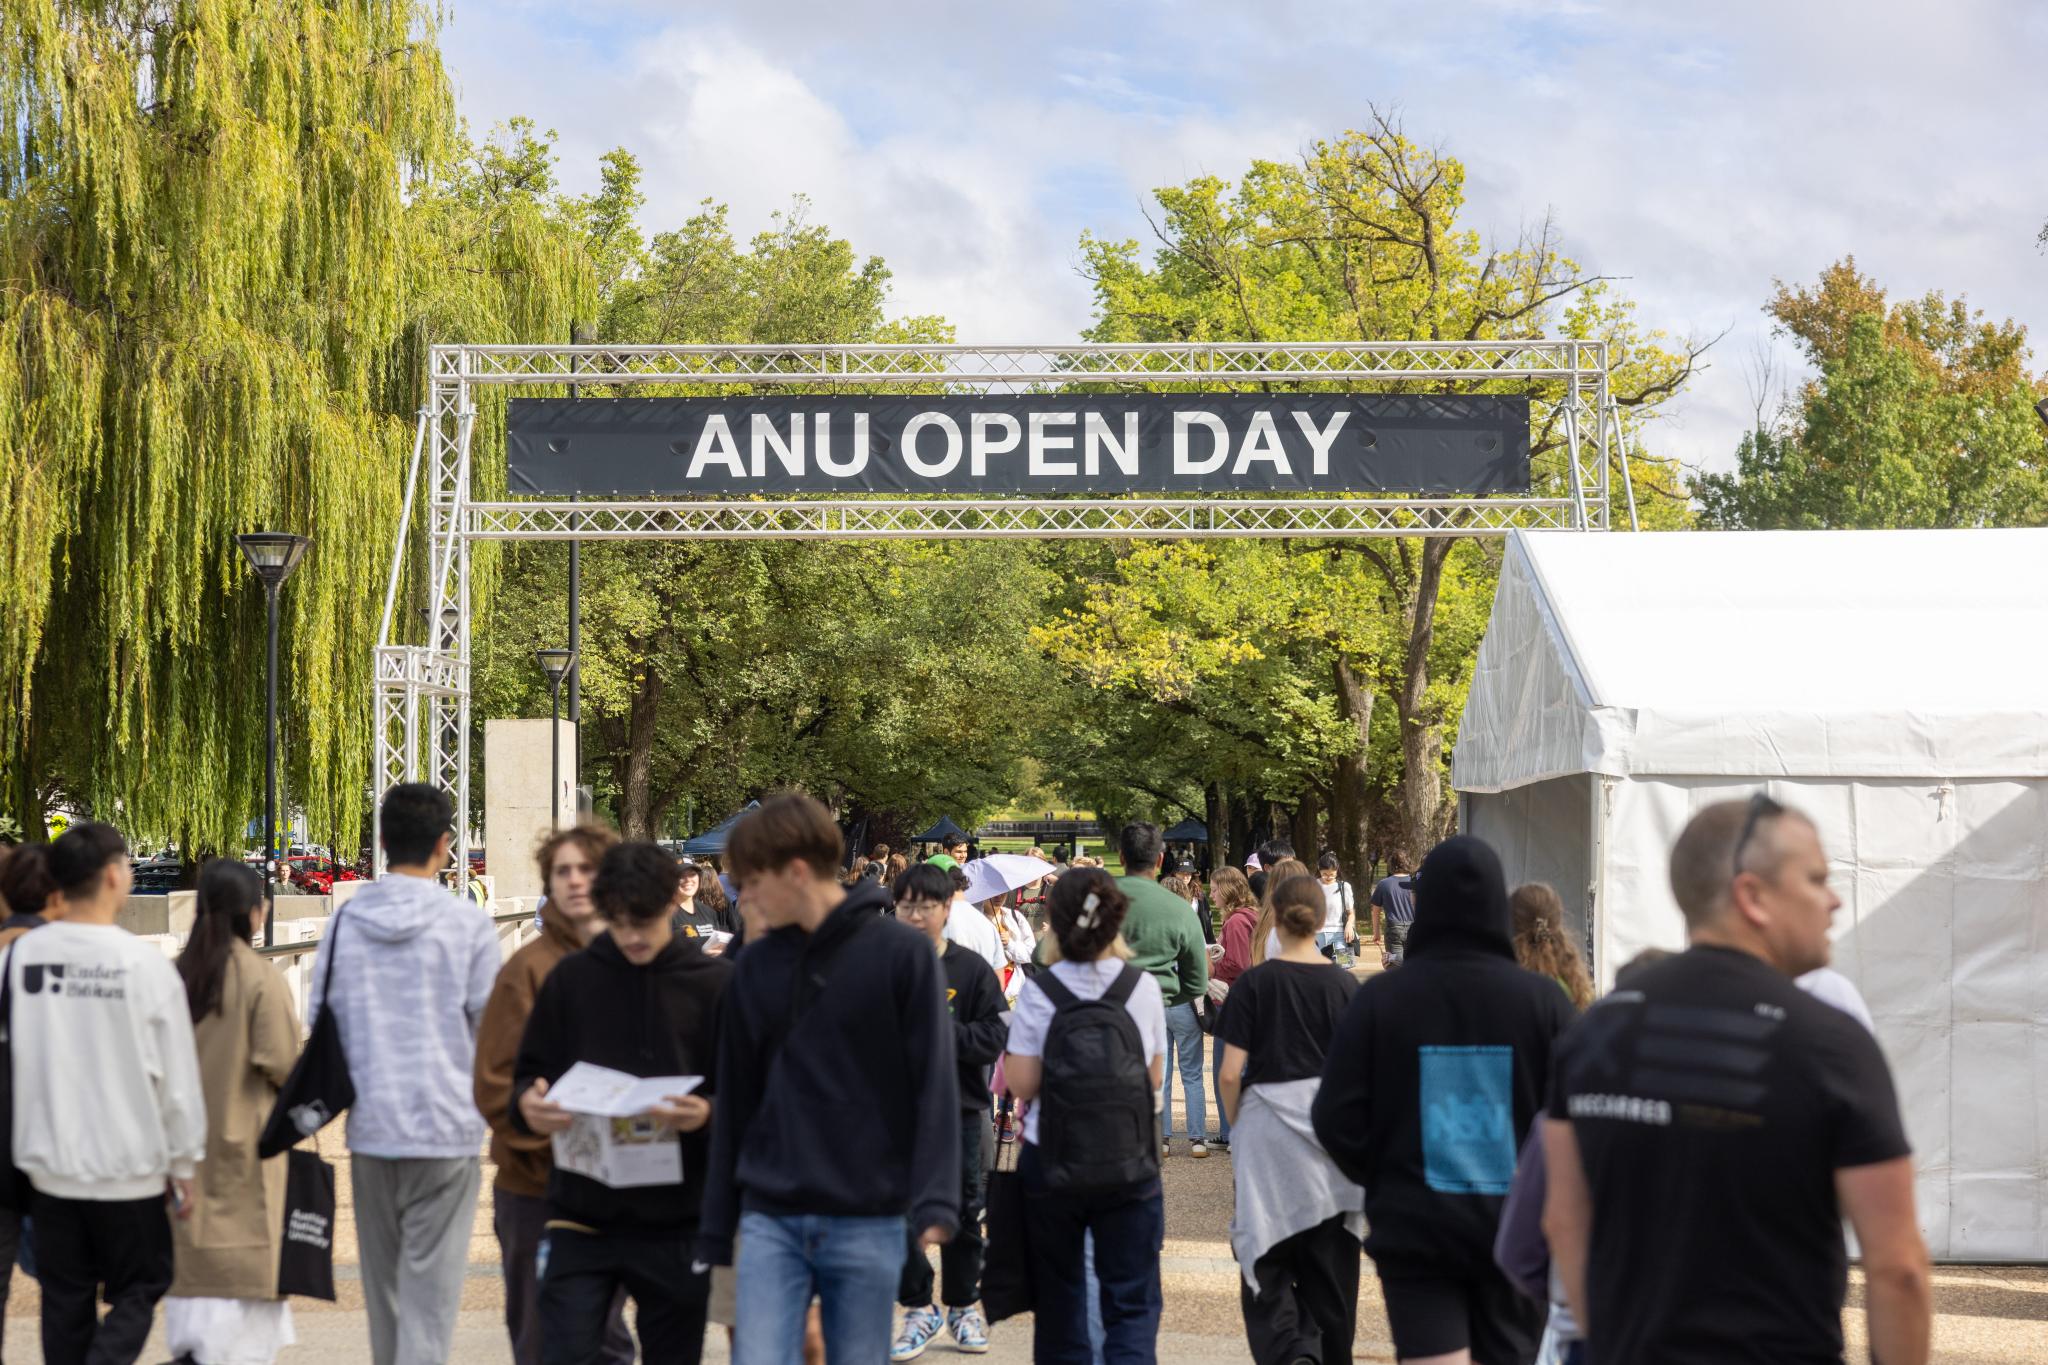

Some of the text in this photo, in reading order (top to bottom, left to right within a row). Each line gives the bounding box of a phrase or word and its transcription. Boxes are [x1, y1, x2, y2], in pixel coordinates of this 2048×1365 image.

[686, 411, 1351, 477] ANU OPEN DAY
